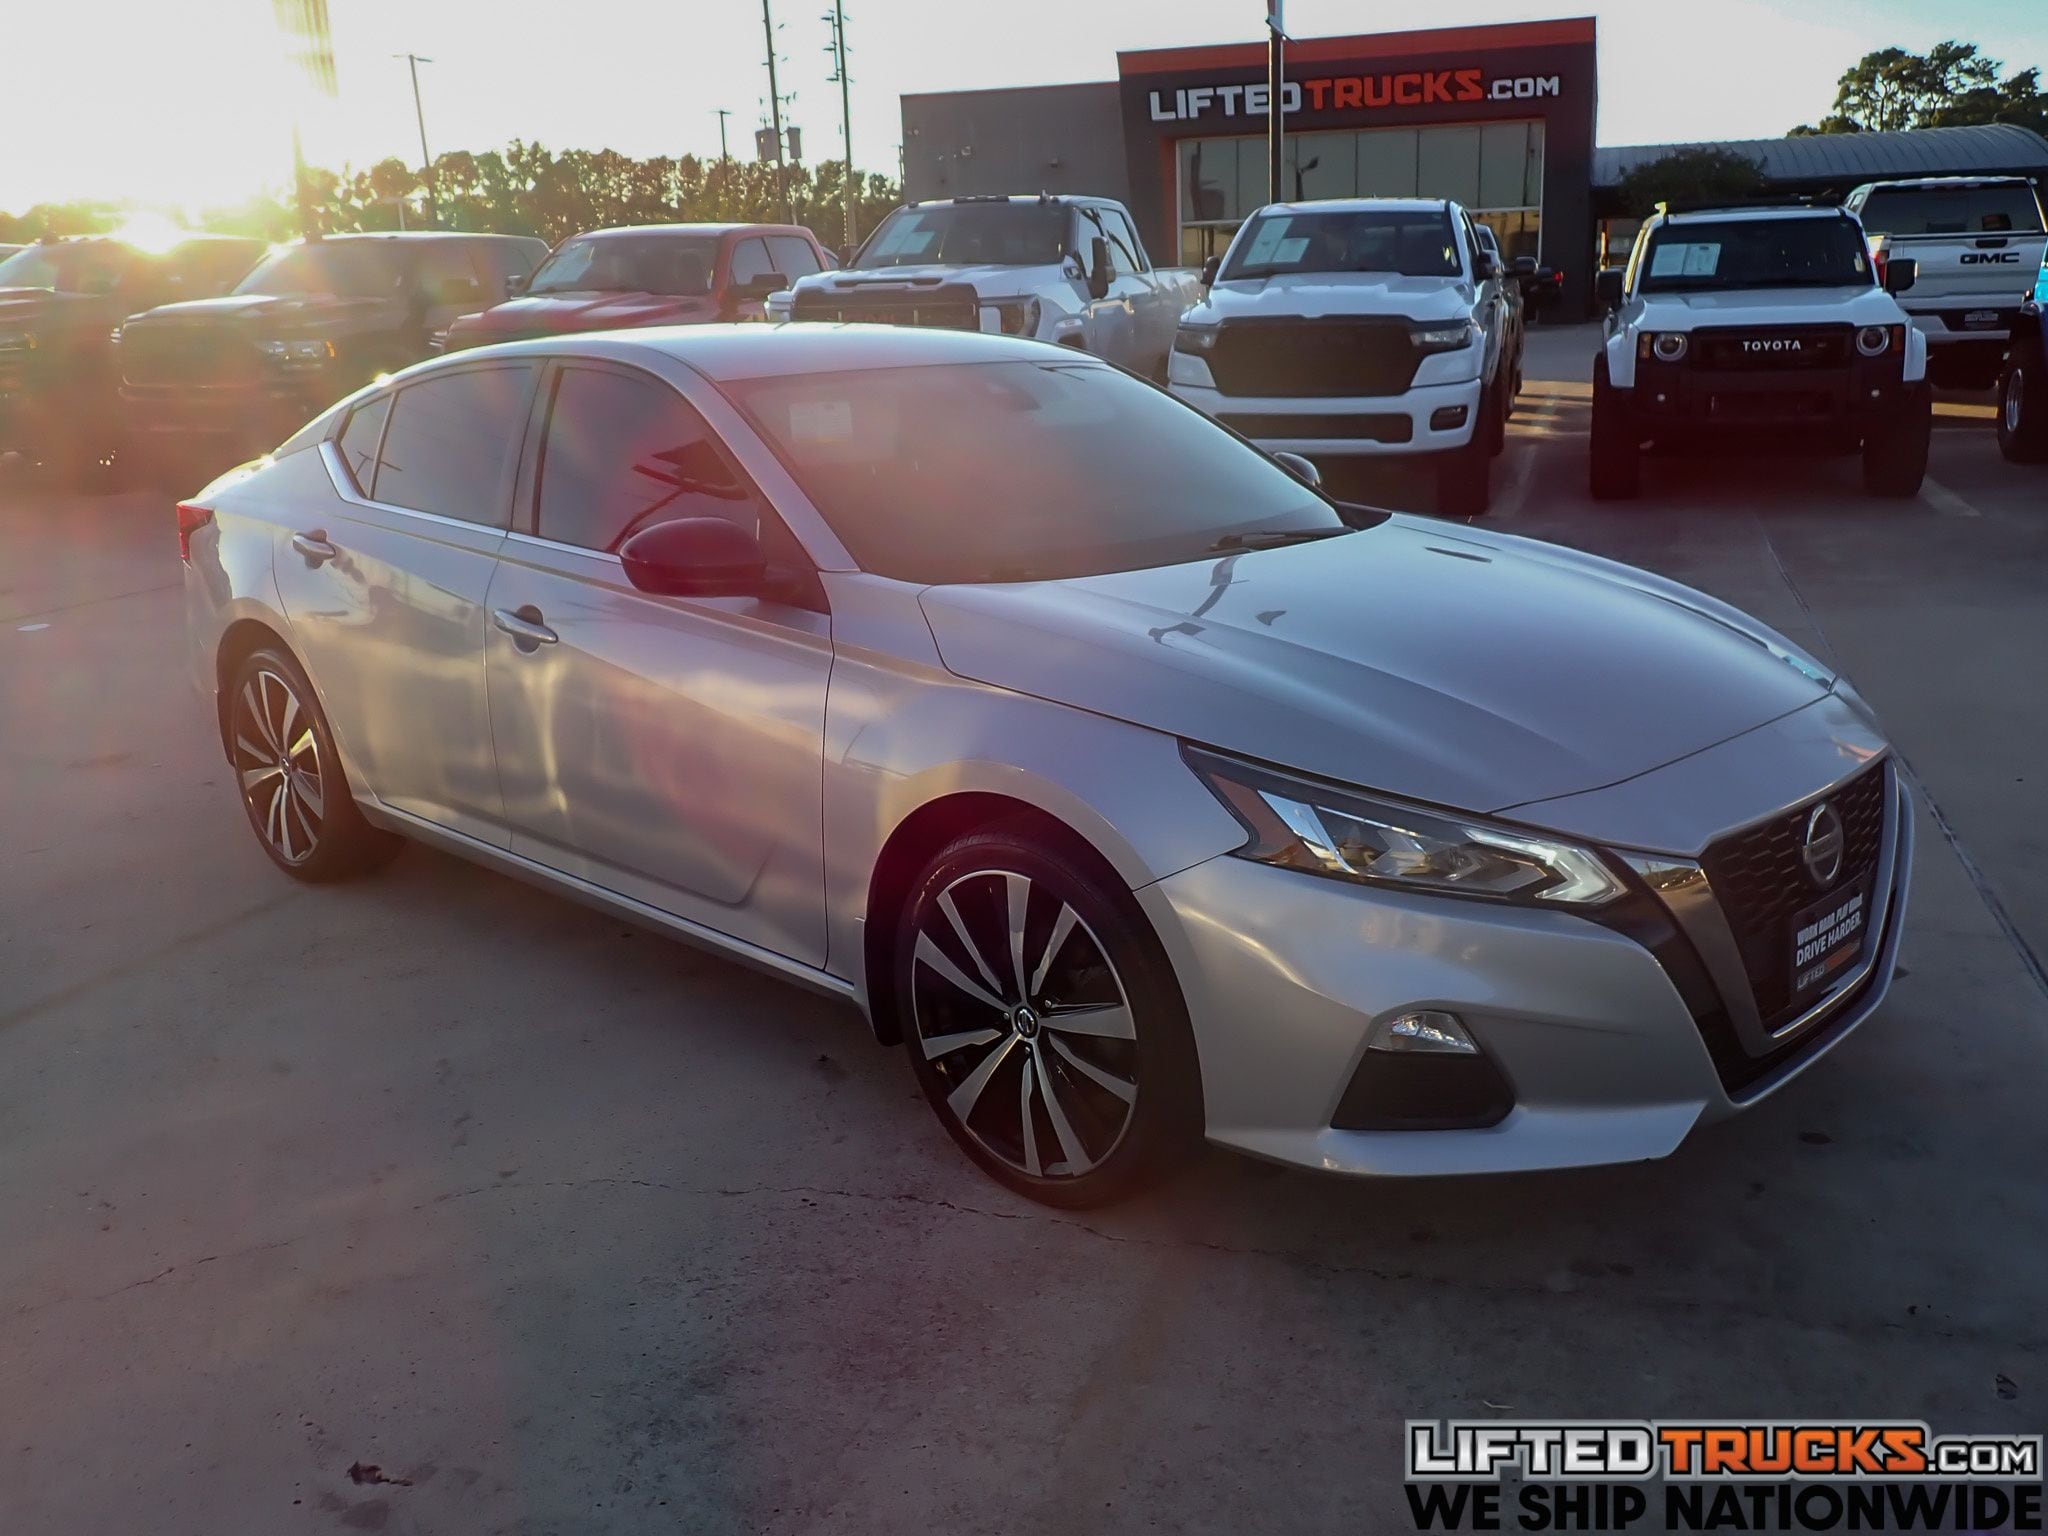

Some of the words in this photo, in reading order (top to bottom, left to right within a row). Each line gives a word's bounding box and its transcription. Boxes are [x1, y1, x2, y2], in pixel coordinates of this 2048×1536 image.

[1960, 252, 2020, 264] GMC
[1743, 340, 1801, 351] TOYOTA
[1796, 935, 1827, 967] DRIVE
